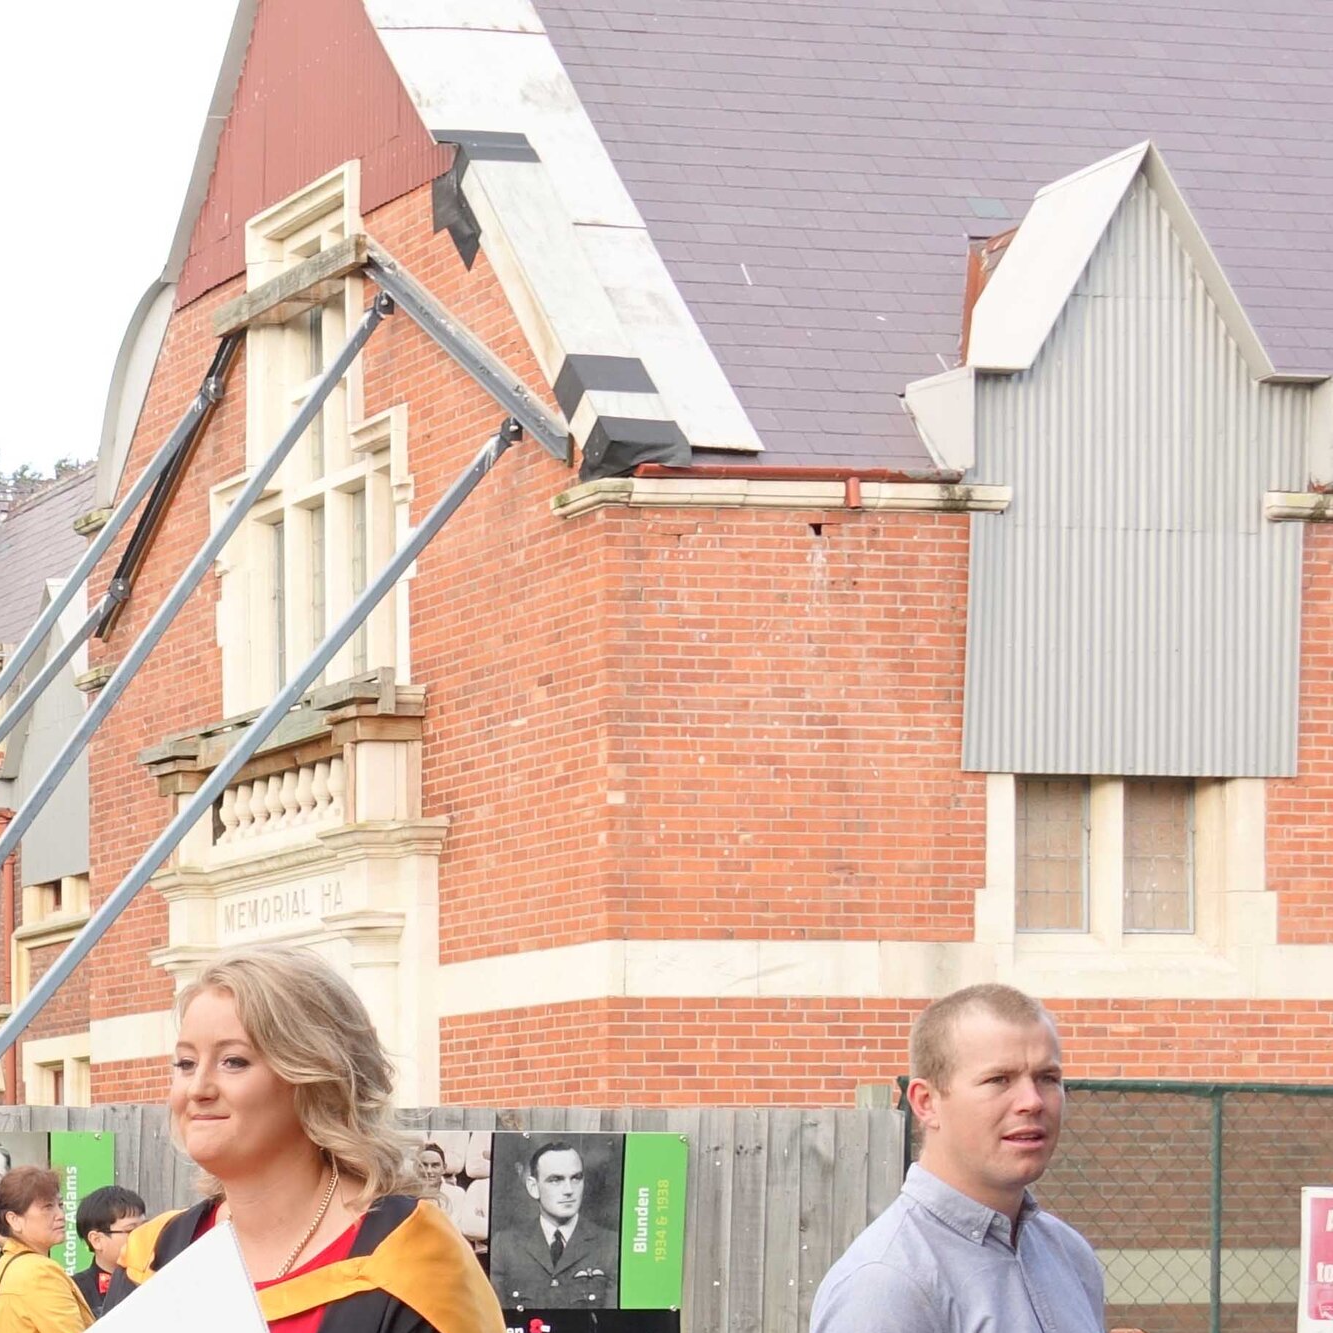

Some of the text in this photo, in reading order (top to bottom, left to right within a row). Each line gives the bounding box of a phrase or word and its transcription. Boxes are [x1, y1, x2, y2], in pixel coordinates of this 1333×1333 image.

[225, 889, 311, 932] MEMORIAL
[657, 1180, 669, 1212] 1938
[633, 1187, 649, 1252] Blunden
[655, 1230, 667, 1262] 1934
